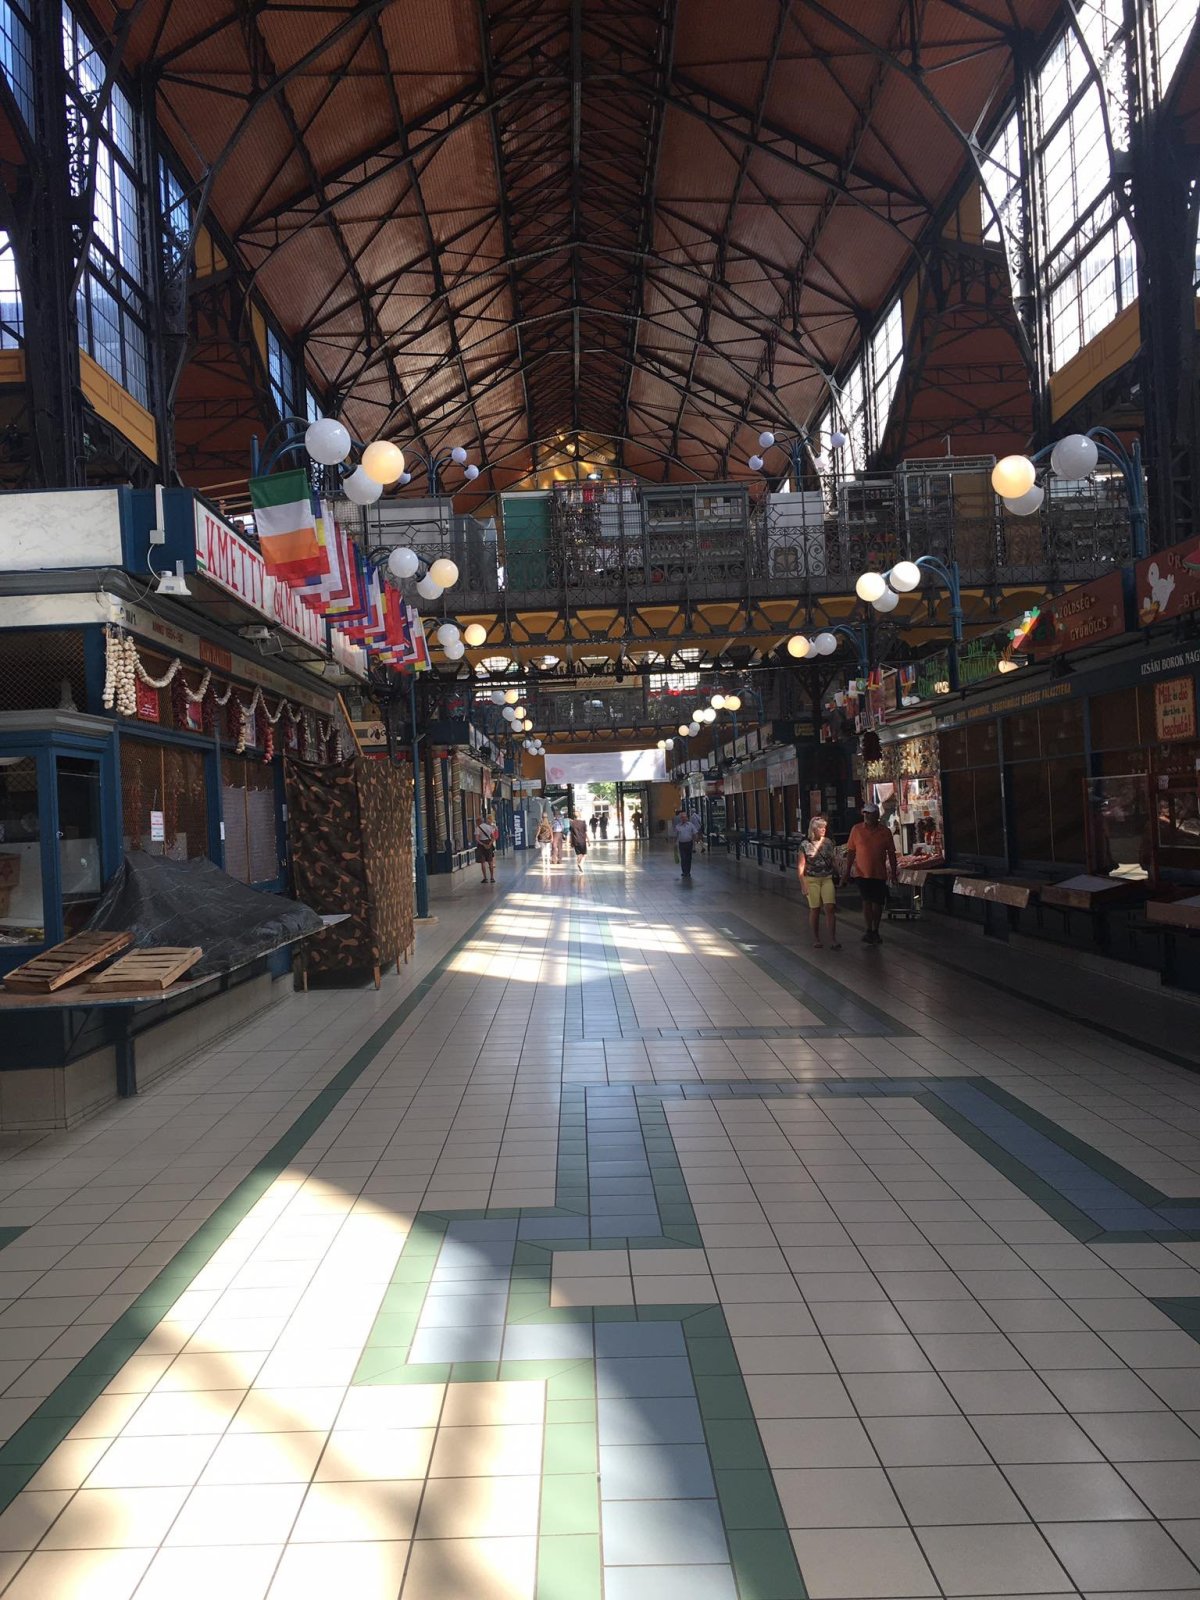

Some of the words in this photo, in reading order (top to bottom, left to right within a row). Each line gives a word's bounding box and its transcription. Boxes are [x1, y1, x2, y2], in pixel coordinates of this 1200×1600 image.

[206, 516, 267, 611] KMETTY
[1070, 616, 1108, 641] GYÜMÖLCS
[1161, 653, 1185, 671] BOROK
[1185, 649, 1200, 665] NAG
